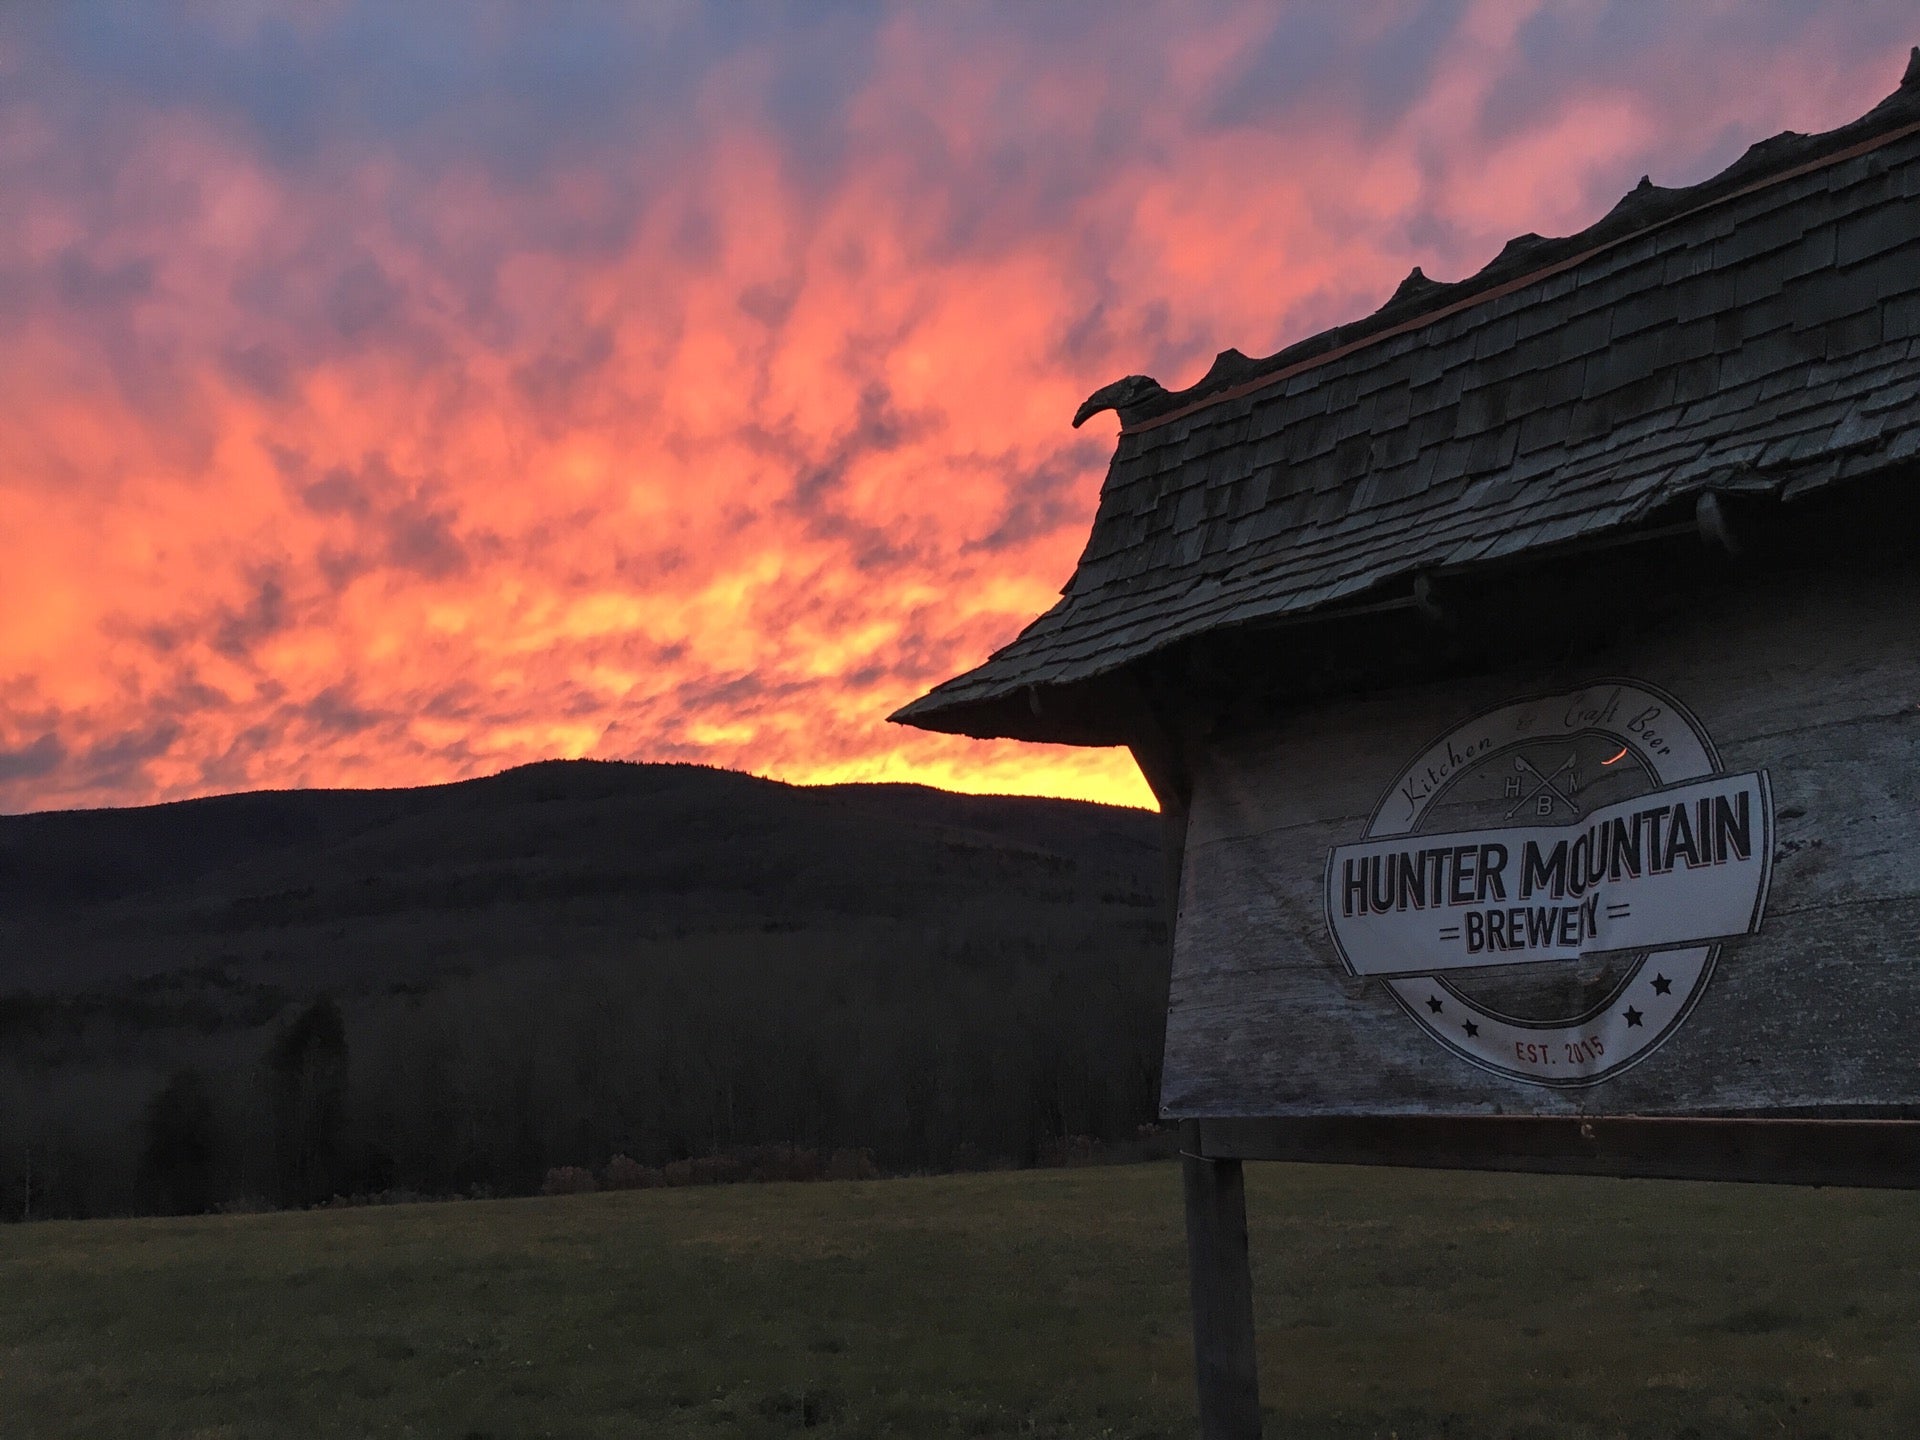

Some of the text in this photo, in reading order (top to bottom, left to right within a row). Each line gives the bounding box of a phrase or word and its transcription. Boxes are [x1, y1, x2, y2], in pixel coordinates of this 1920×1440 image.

[1401, 737, 1492, 822] Kitchen
[1564, 687, 1622, 728] Craft
[1626, 705, 1671, 756] Beer
[1504, 775, 1522, 798] H
[1536, 795, 1554, 817] B
[1342, 790, 1752, 917] HUNTER MOUNTAIN
[1515, 1035, 1606, 1065] EST. 2015
